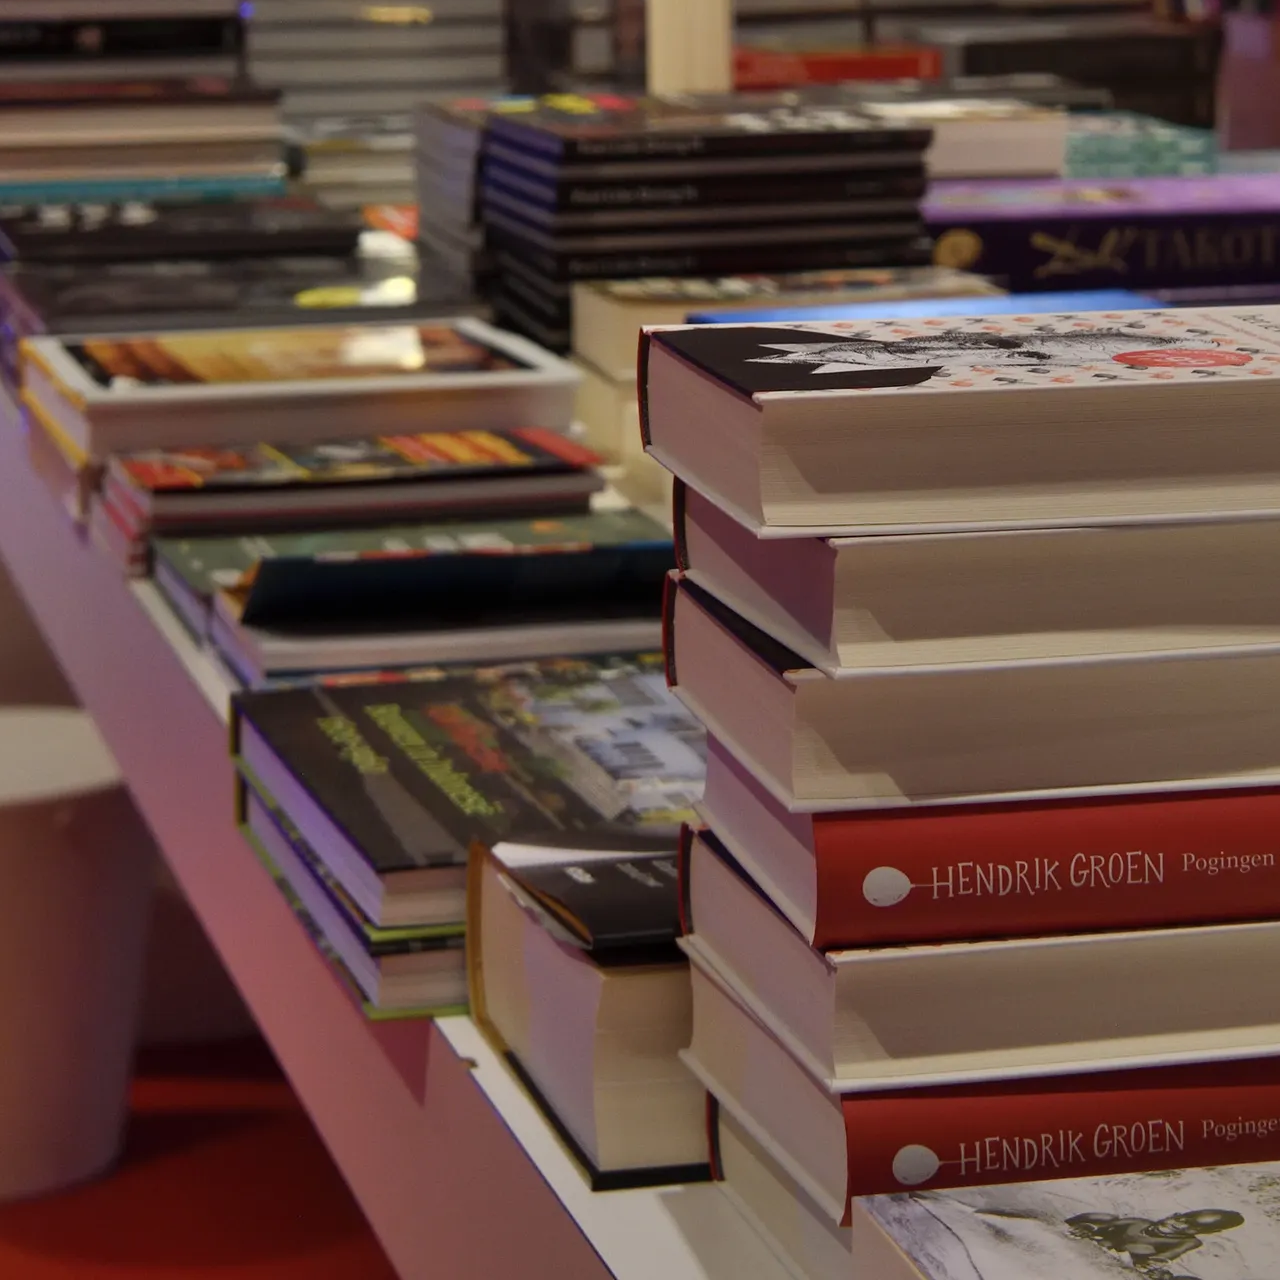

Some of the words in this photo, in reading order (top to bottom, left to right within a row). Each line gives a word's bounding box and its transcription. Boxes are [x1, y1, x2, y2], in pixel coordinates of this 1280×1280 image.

[931, 857, 1063, 900] HENDRIK
[1070, 850, 1165, 889] GROEN
[1182, 850, 1275, 874] Pogingen
[959, 1130, 1085, 1176] HENDRIK
[1093, 1119, 1185, 1159] GROEN
